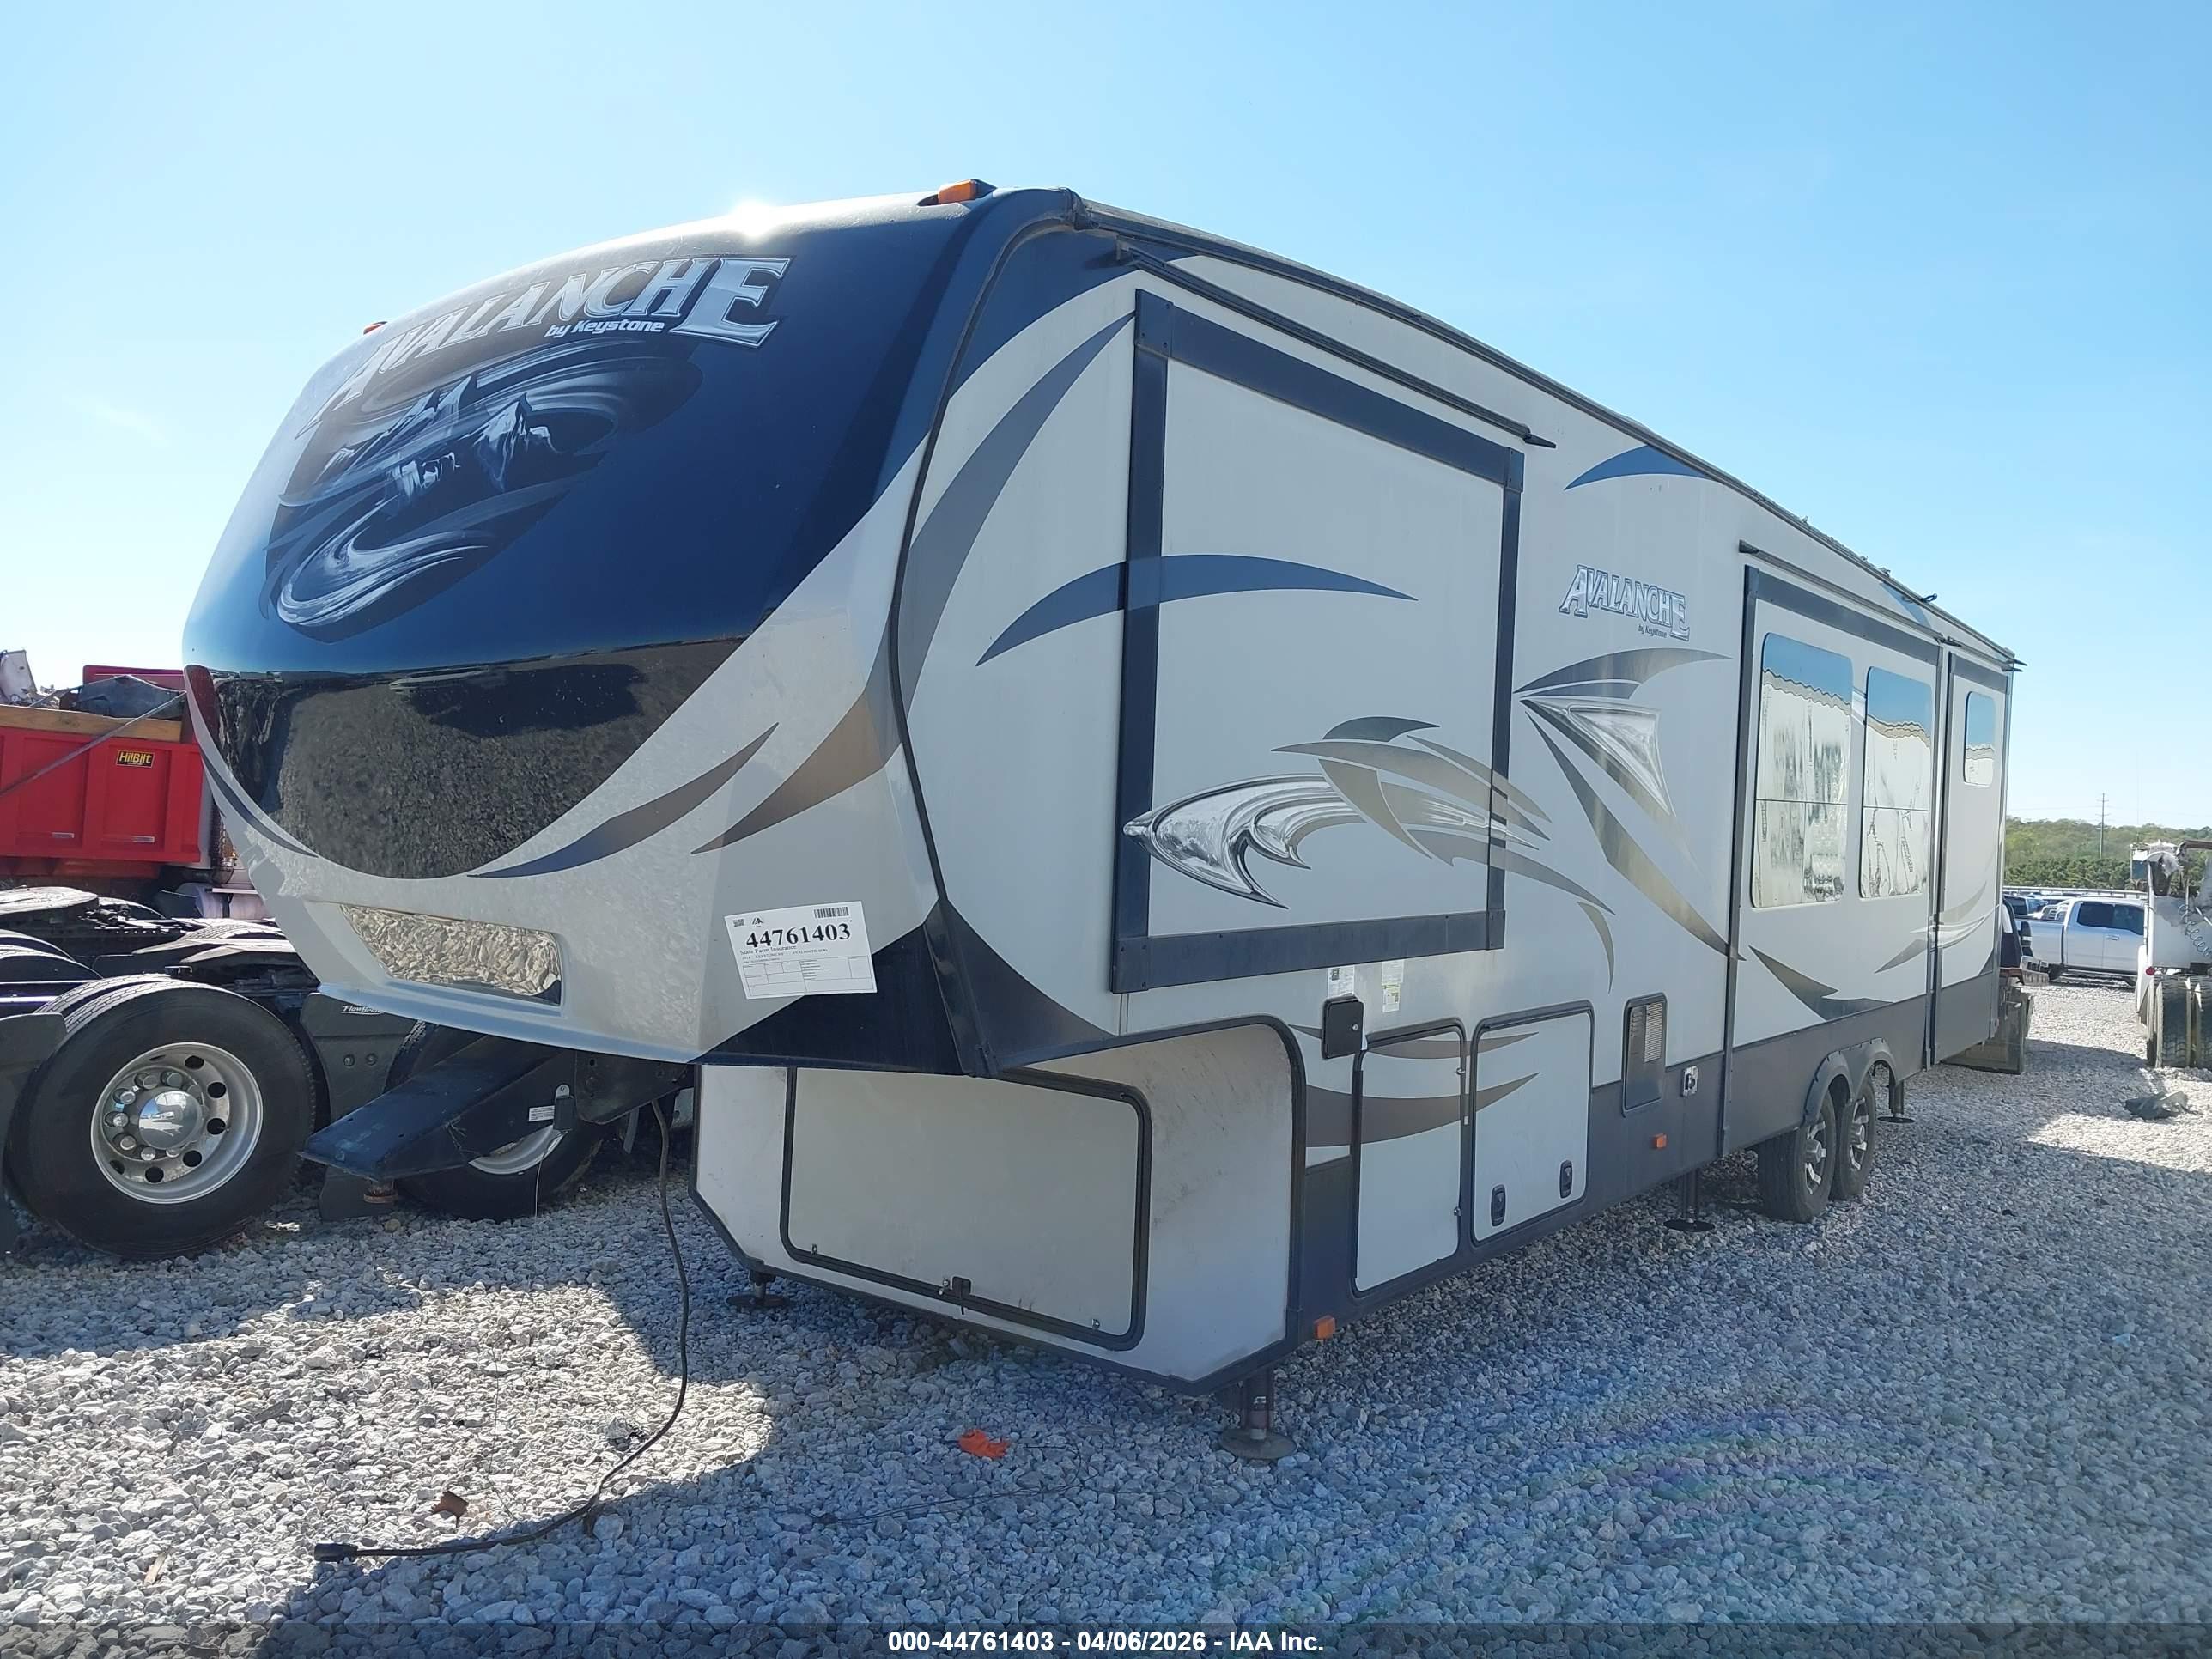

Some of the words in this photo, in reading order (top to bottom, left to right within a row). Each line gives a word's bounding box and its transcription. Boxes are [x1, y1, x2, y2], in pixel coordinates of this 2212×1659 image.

[544, 324, 572, 338] by
[571, 319, 665, 335] Keystone
[294, 256, 796, 440] AVALANCHE
[1559, 564, 1690, 641] AVALANCHE
[1638, 624, 1645, 635] by
[118, 751, 152, 764] HilBilt
[746, 923, 851, 948] 44761403
